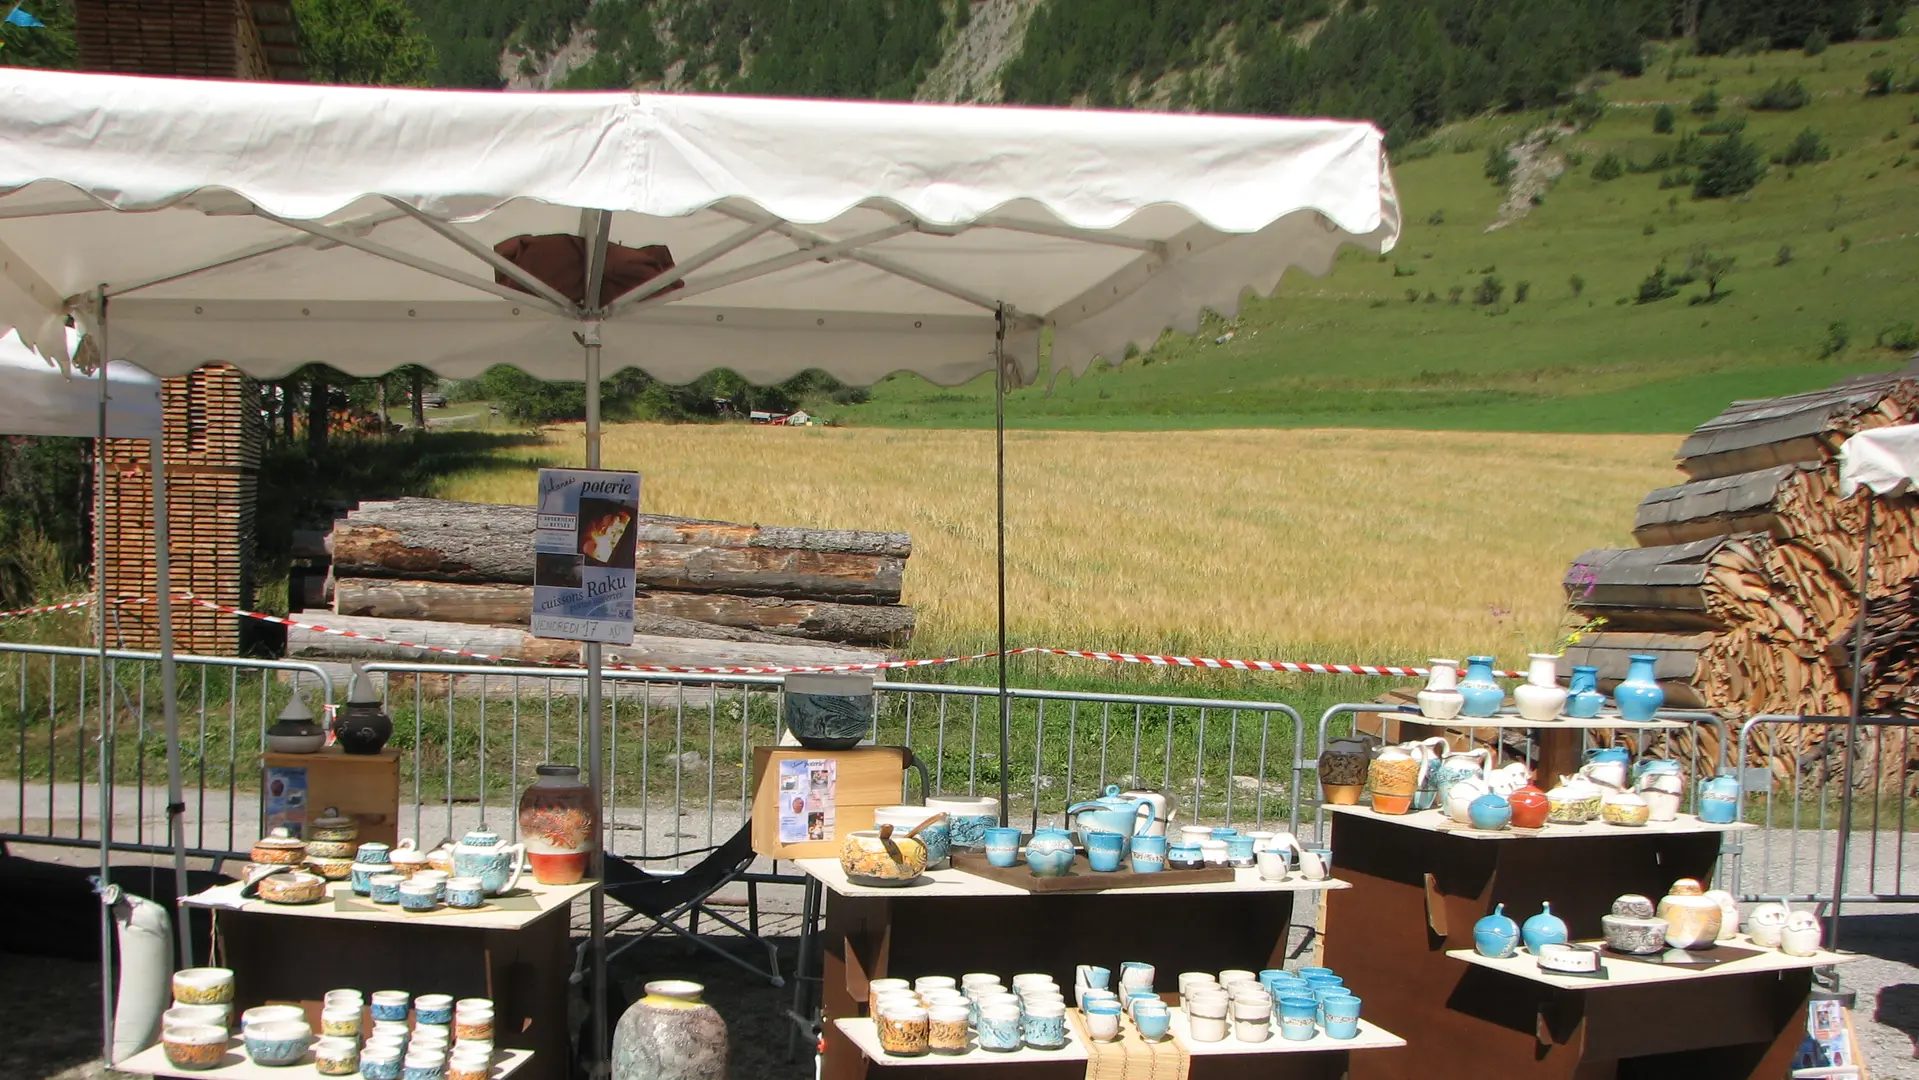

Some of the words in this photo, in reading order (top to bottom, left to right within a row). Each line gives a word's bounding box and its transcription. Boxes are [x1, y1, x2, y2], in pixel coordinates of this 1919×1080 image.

[580, 478, 632, 497] poterie
[541, 590, 584, 611] cuissons
[586, 575, 627, 598] Raku
[533, 619, 579, 635] VENDREDI
[582, 621, 599, 638] 17
